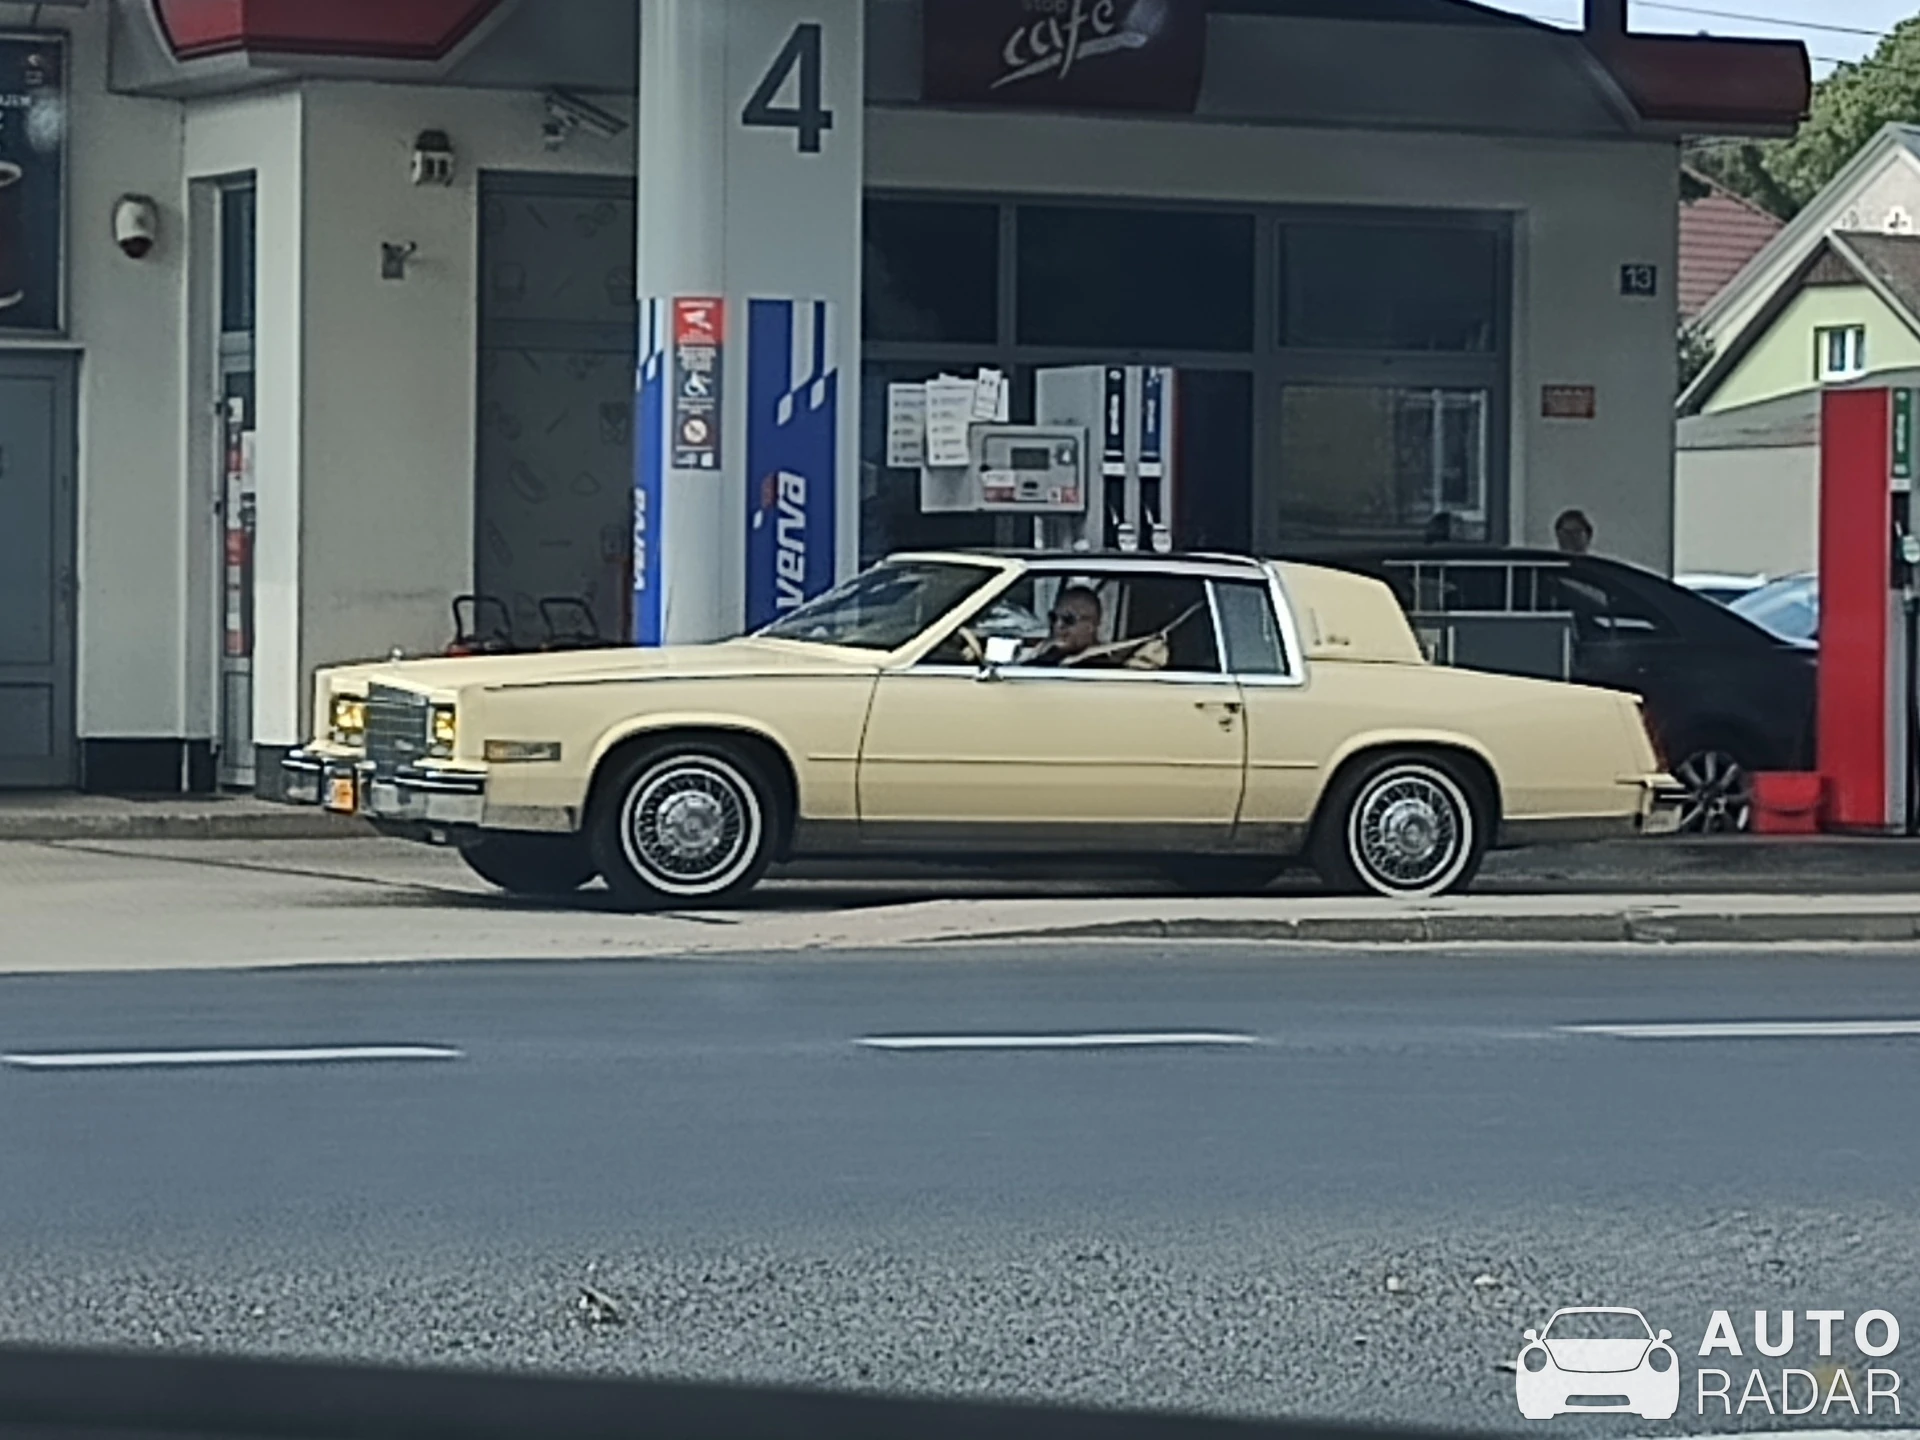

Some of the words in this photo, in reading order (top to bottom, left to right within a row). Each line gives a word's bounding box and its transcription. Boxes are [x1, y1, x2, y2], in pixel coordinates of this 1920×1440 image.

[742, 24, 833, 153] 4
[1625, 267, 1652, 288] 13
[776, 471, 807, 609] verva
